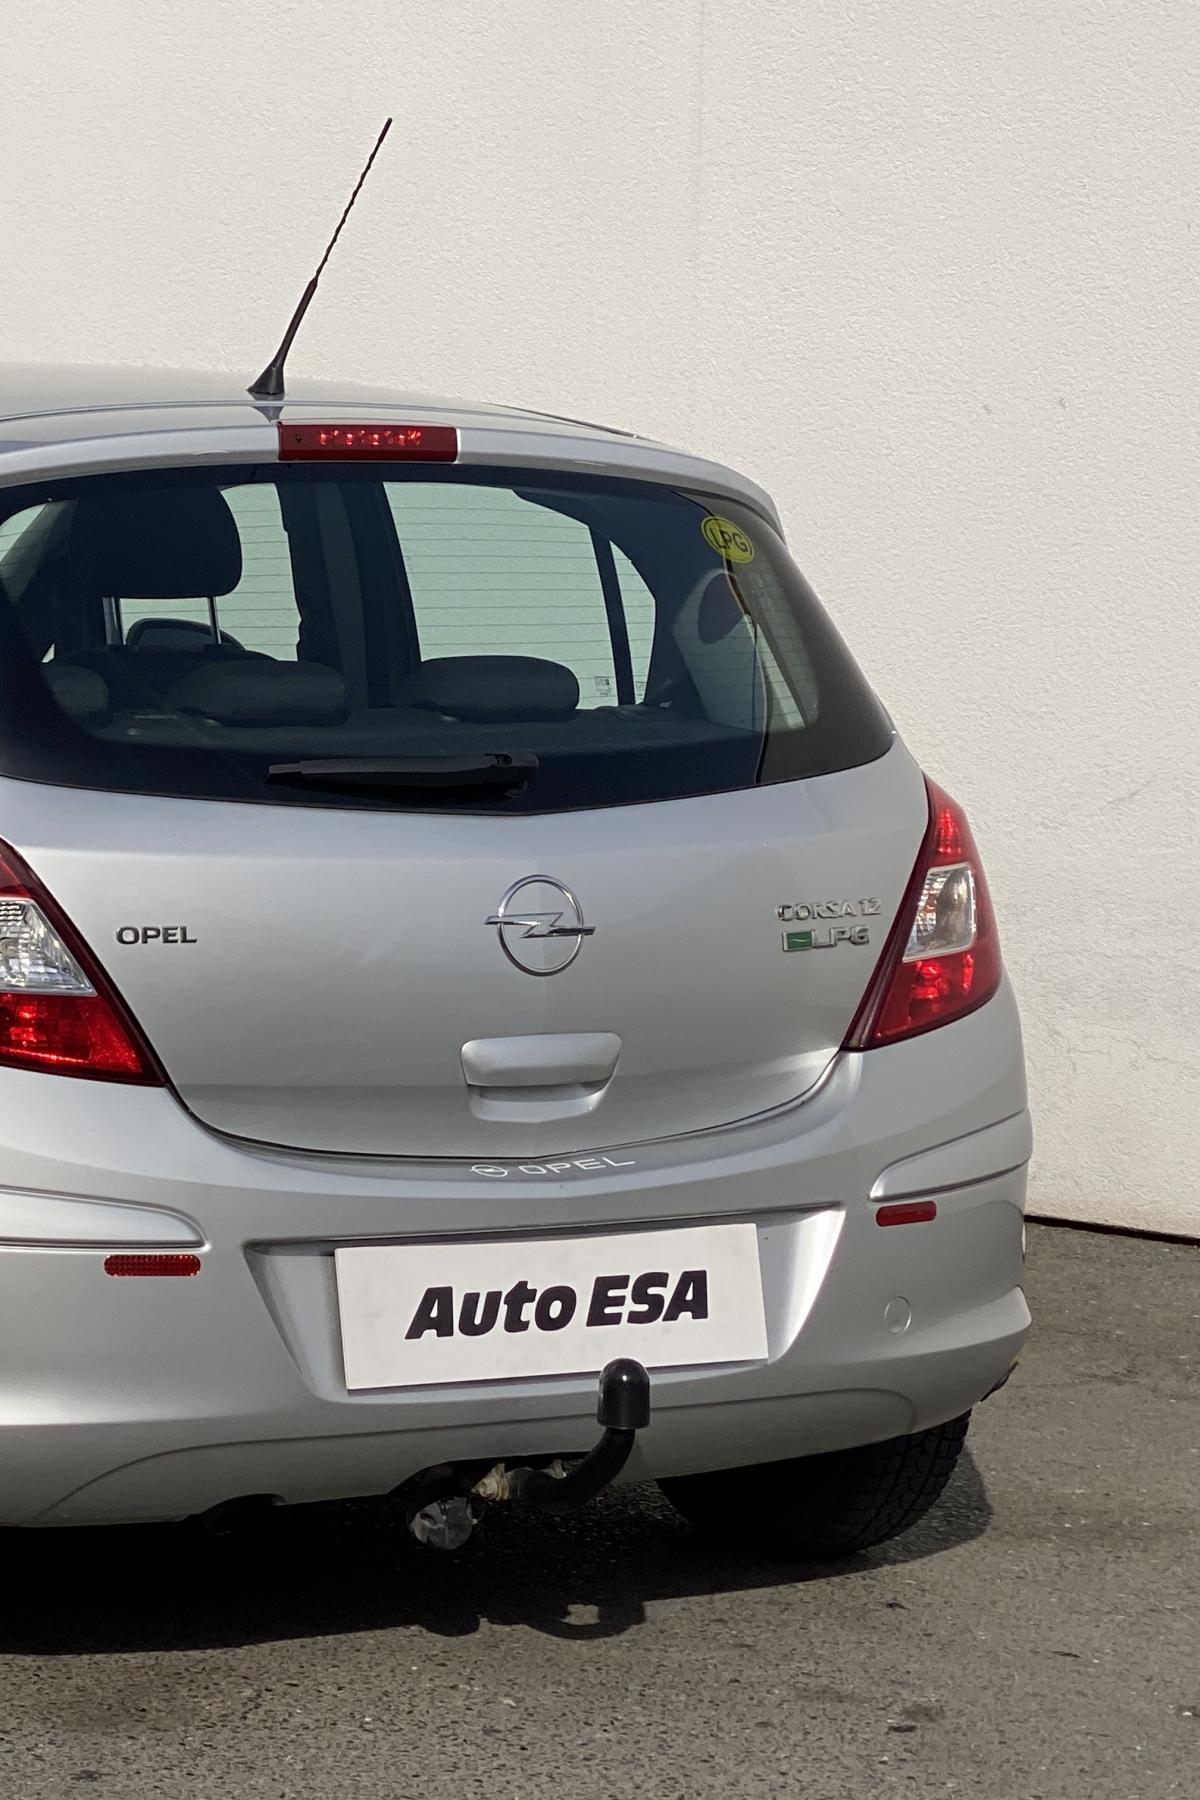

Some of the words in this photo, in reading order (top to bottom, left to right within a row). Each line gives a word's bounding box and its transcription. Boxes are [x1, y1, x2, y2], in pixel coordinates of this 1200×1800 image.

[708, 526, 749, 553] LPG
[776, 900, 857, 921] CORSA
[116, 926, 198, 945] OPEL
[811, 925, 870, 949] LPG
[518, 1156, 636, 1175] OPEL
[404, 1280, 577, 1340] Auto
[586, 1269, 709, 1328] ESA
